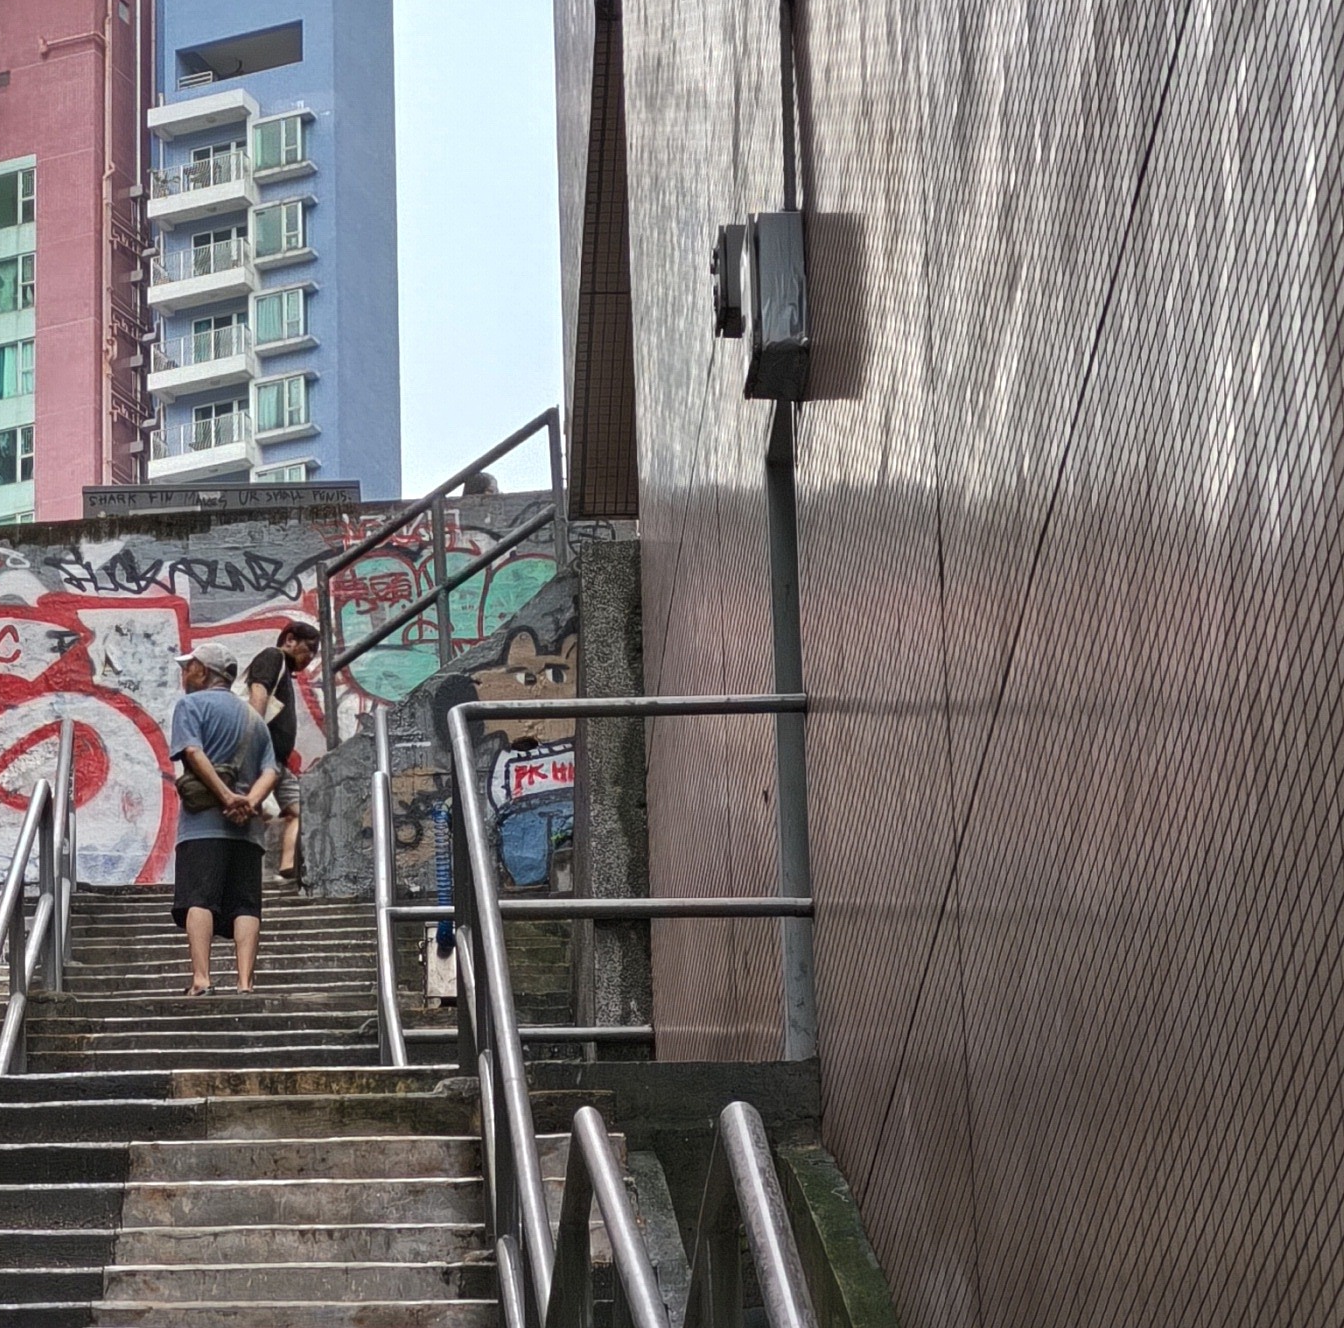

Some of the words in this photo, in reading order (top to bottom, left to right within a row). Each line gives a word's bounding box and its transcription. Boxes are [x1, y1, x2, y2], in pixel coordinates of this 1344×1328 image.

[89, 492, 137, 507] SHARK
[149, 490, 174, 504] FIN
[239, 490, 259, 506] UR
